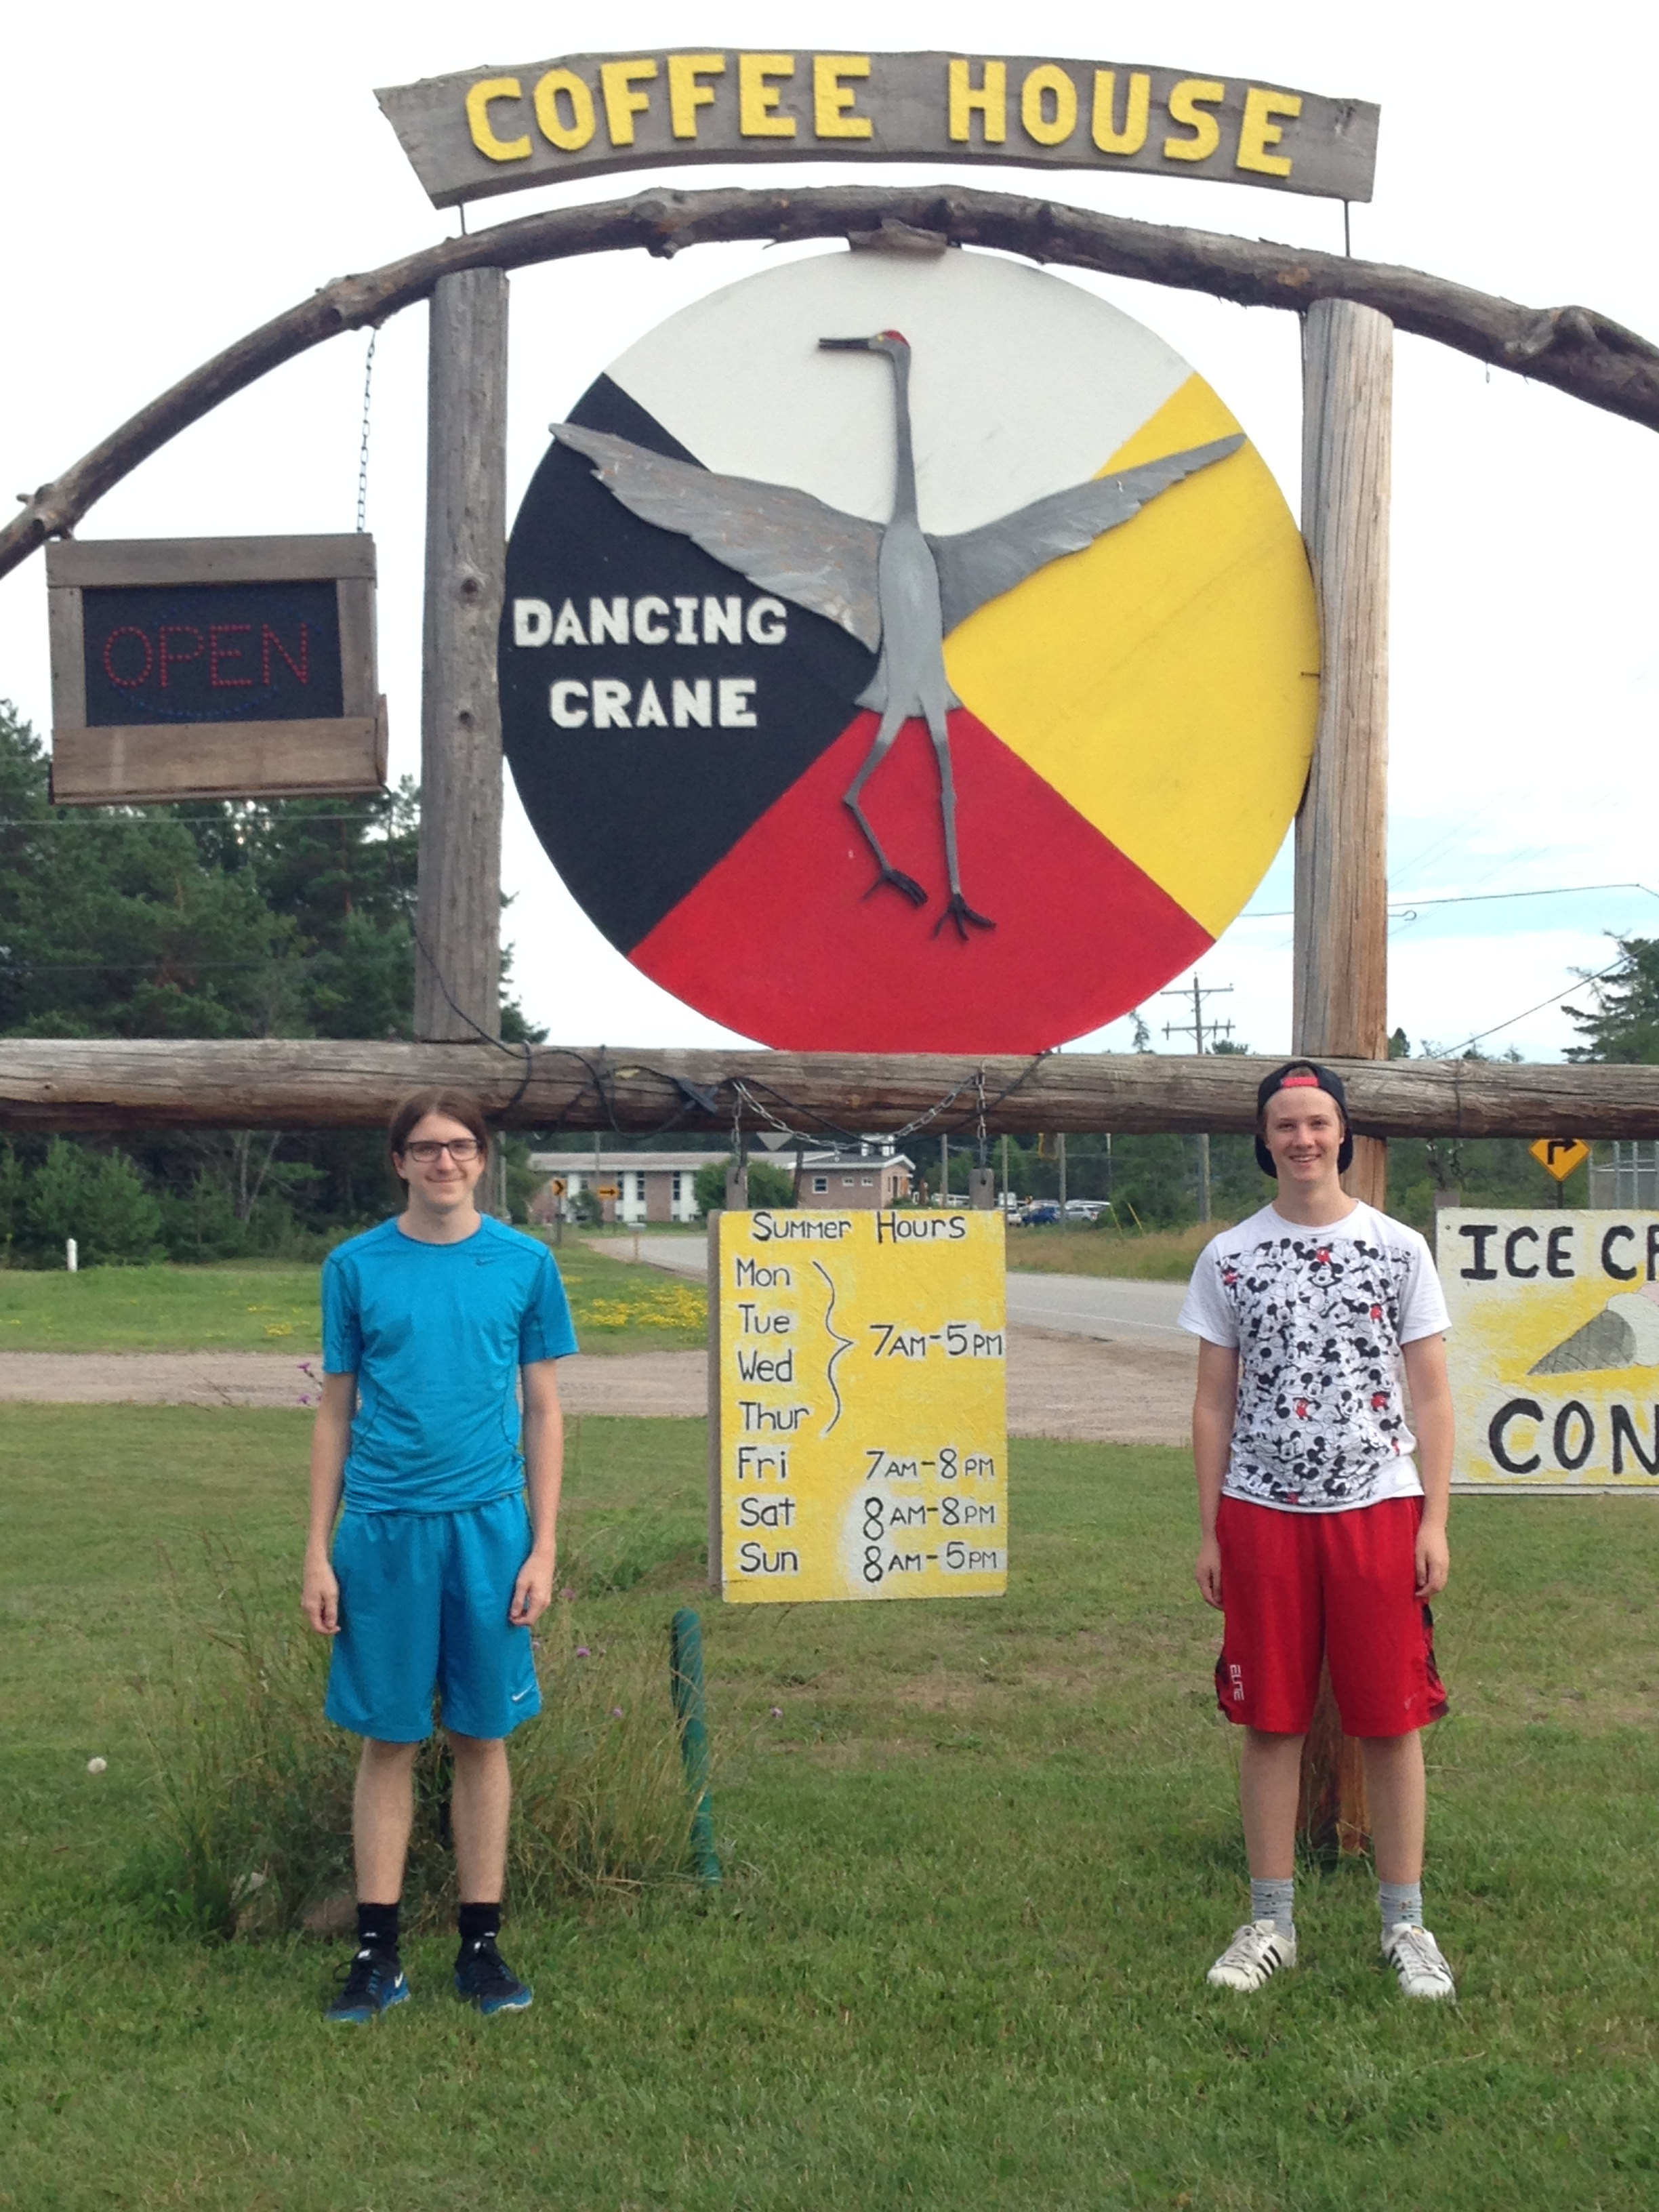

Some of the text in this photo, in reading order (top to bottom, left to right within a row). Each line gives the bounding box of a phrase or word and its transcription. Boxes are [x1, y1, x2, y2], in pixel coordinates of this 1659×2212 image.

[465, 54, 1303, 178] COFFEE HOUSE
[513, 595, 787, 647] DANCING
[102, 623, 309, 689] OPEN
[549, 678, 758, 729] CRANE
[876, 1211, 966, 1244] Hours
[1458, 1225, 1575, 1280] ICE
[736, 1258, 791, 1287] Mon
[738, 1304, 791, 1334] Tue
[737, 1349, 793, 1382] Wed
[739, 1401, 810, 1431] Thur
[738, 1446, 786, 1479] Fri
[740, 1497, 795, 1526] Sat
[740, 1542, 798, 1573] Sun
